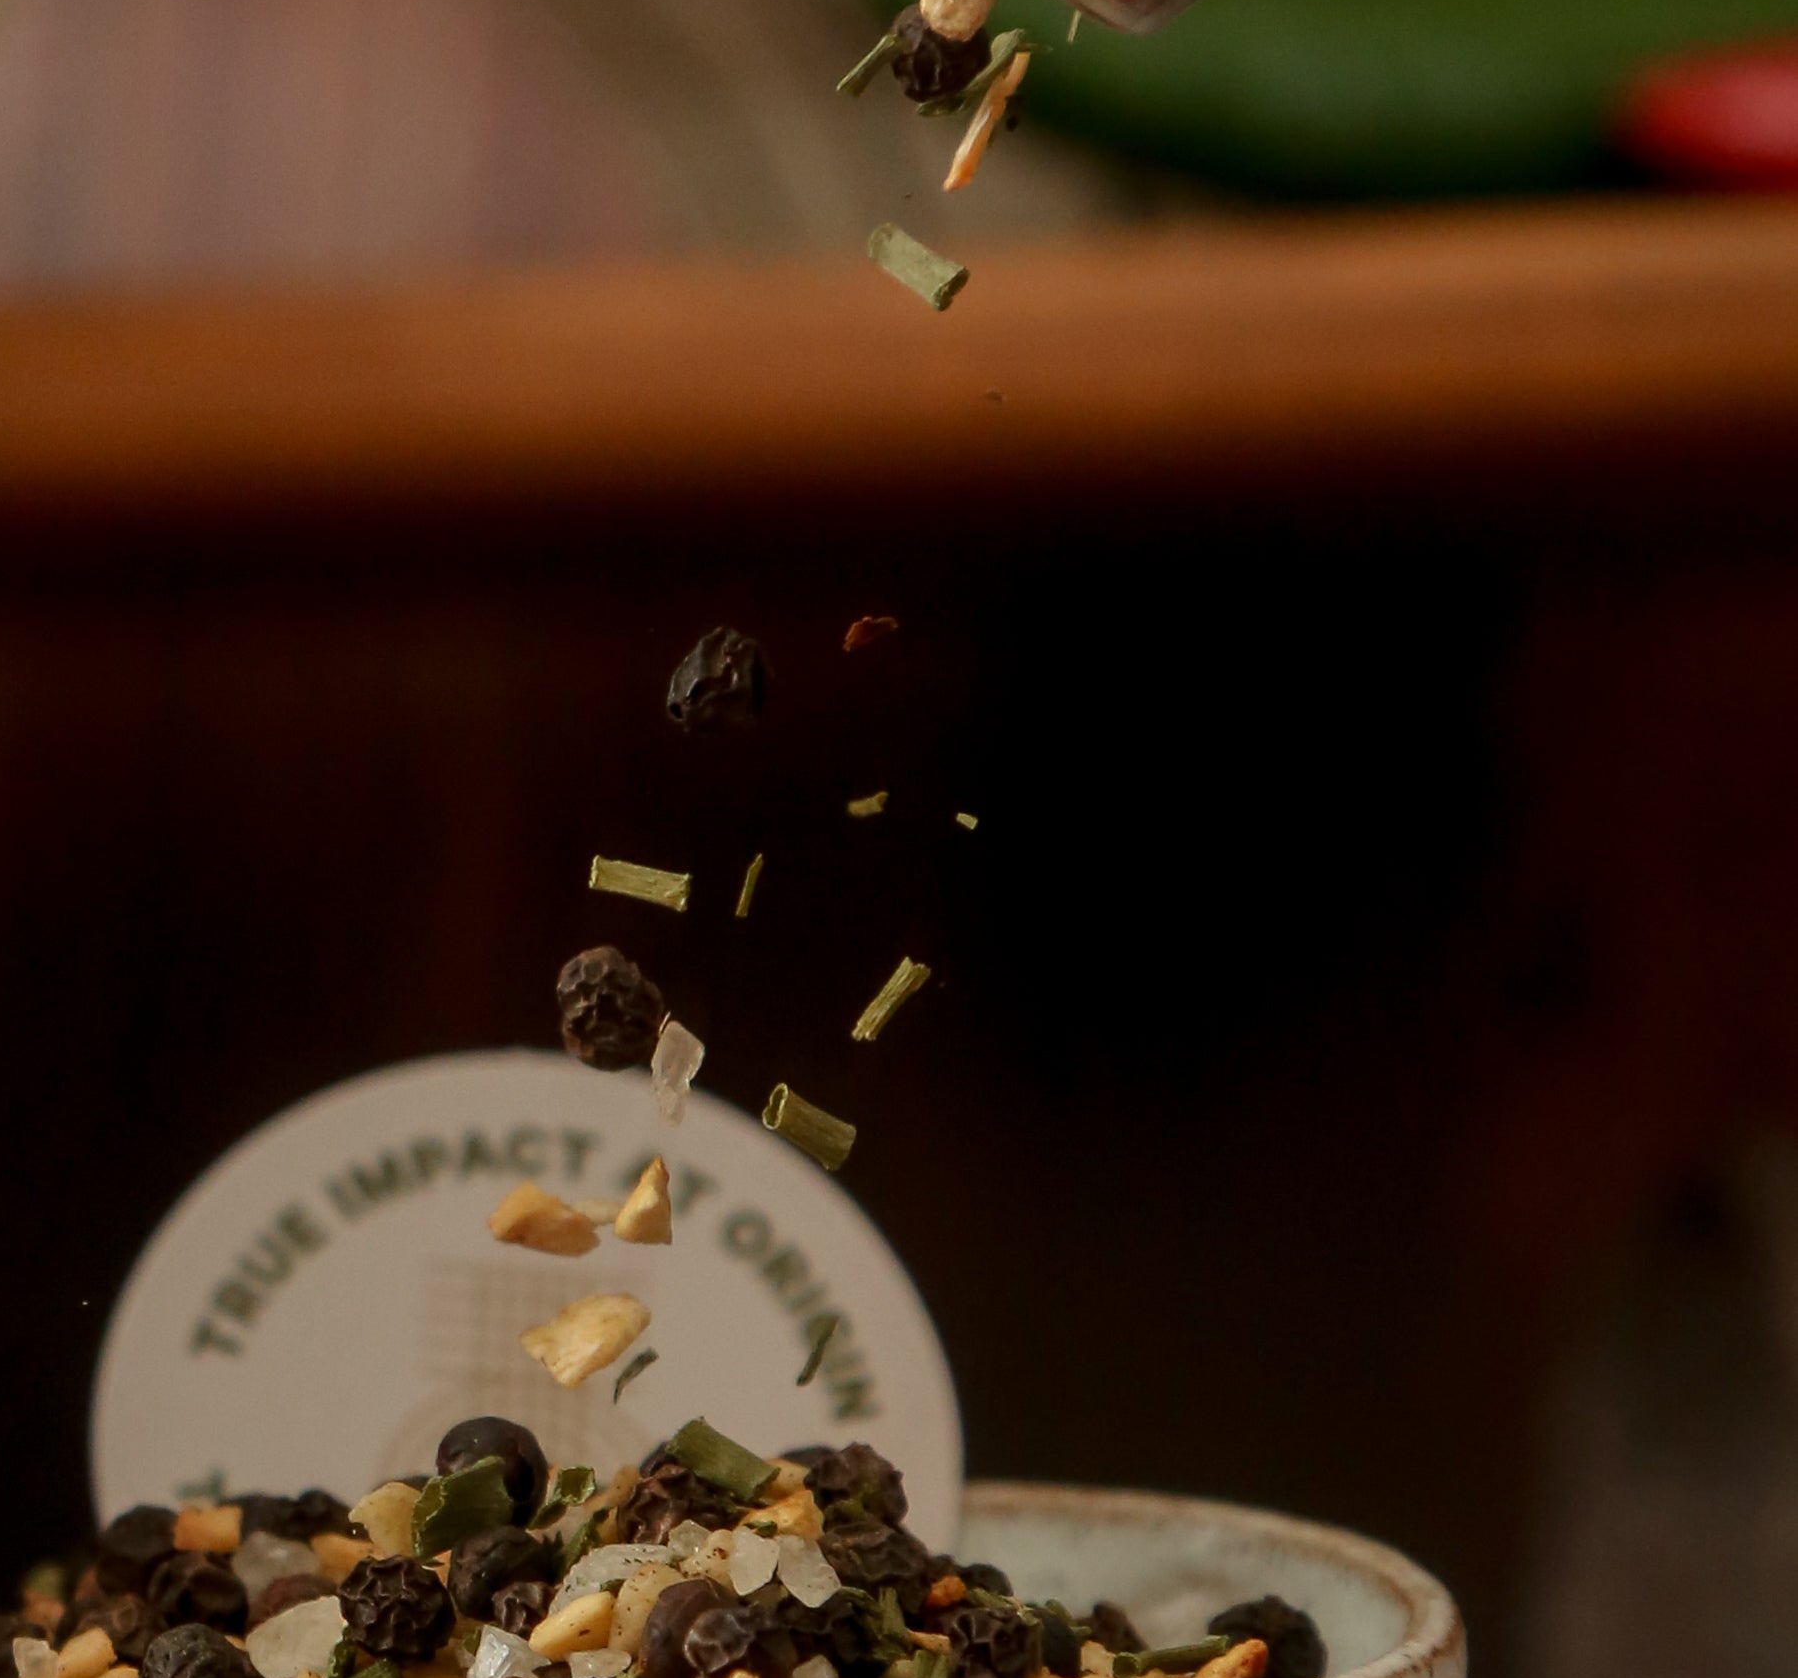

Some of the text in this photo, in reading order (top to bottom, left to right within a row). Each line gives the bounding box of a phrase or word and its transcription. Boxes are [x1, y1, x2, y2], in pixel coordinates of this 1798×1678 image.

[189, 1196, 332, 1360] TRUE
[324, 1124, 598, 1225] IMPACT
[720, 1206, 883, 1422] ORIGIN
